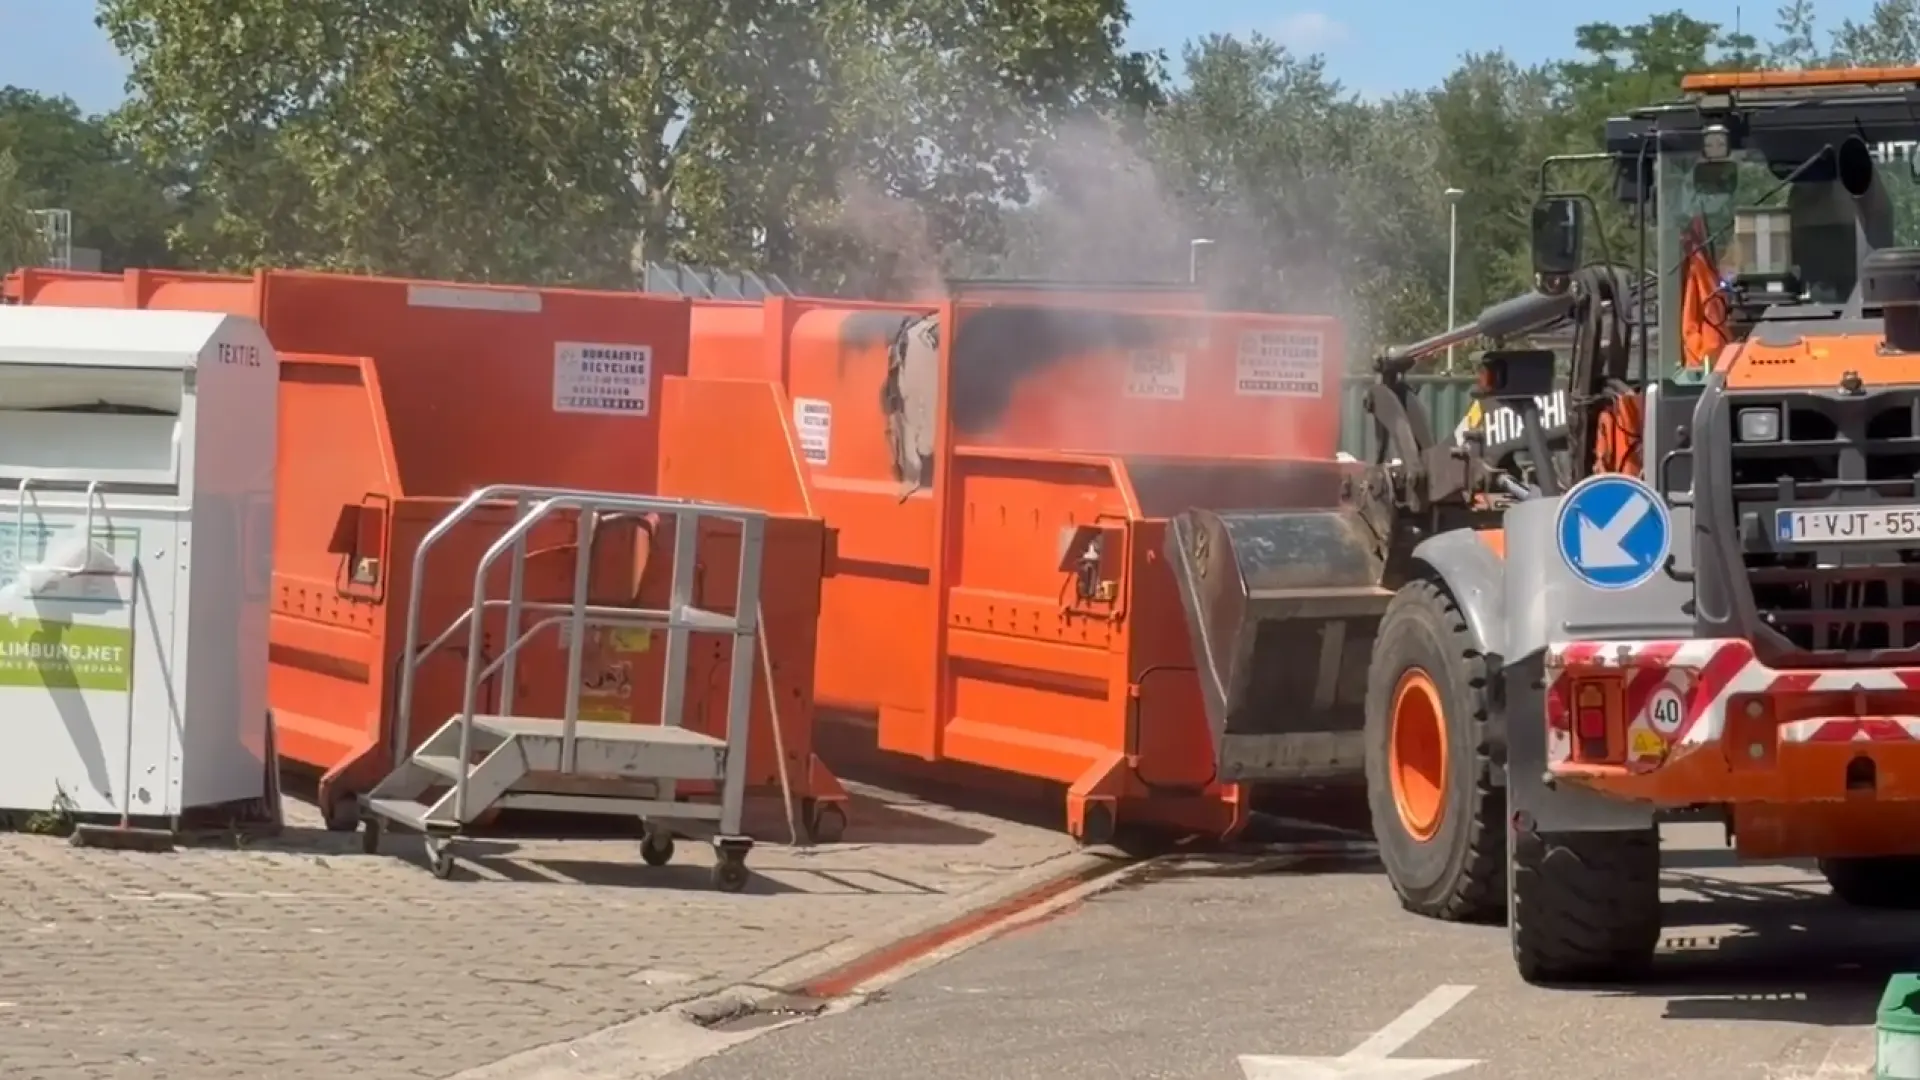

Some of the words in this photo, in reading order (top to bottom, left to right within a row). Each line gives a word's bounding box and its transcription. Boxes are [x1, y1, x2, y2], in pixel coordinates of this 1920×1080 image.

[218, 342, 261, 368] TEXTIEL
[1797, 511, 1920, 538] 1-VJT-55
[0, 641, 124, 661] LIMBURG.NET
[1654, 698, 1679, 724] 40
